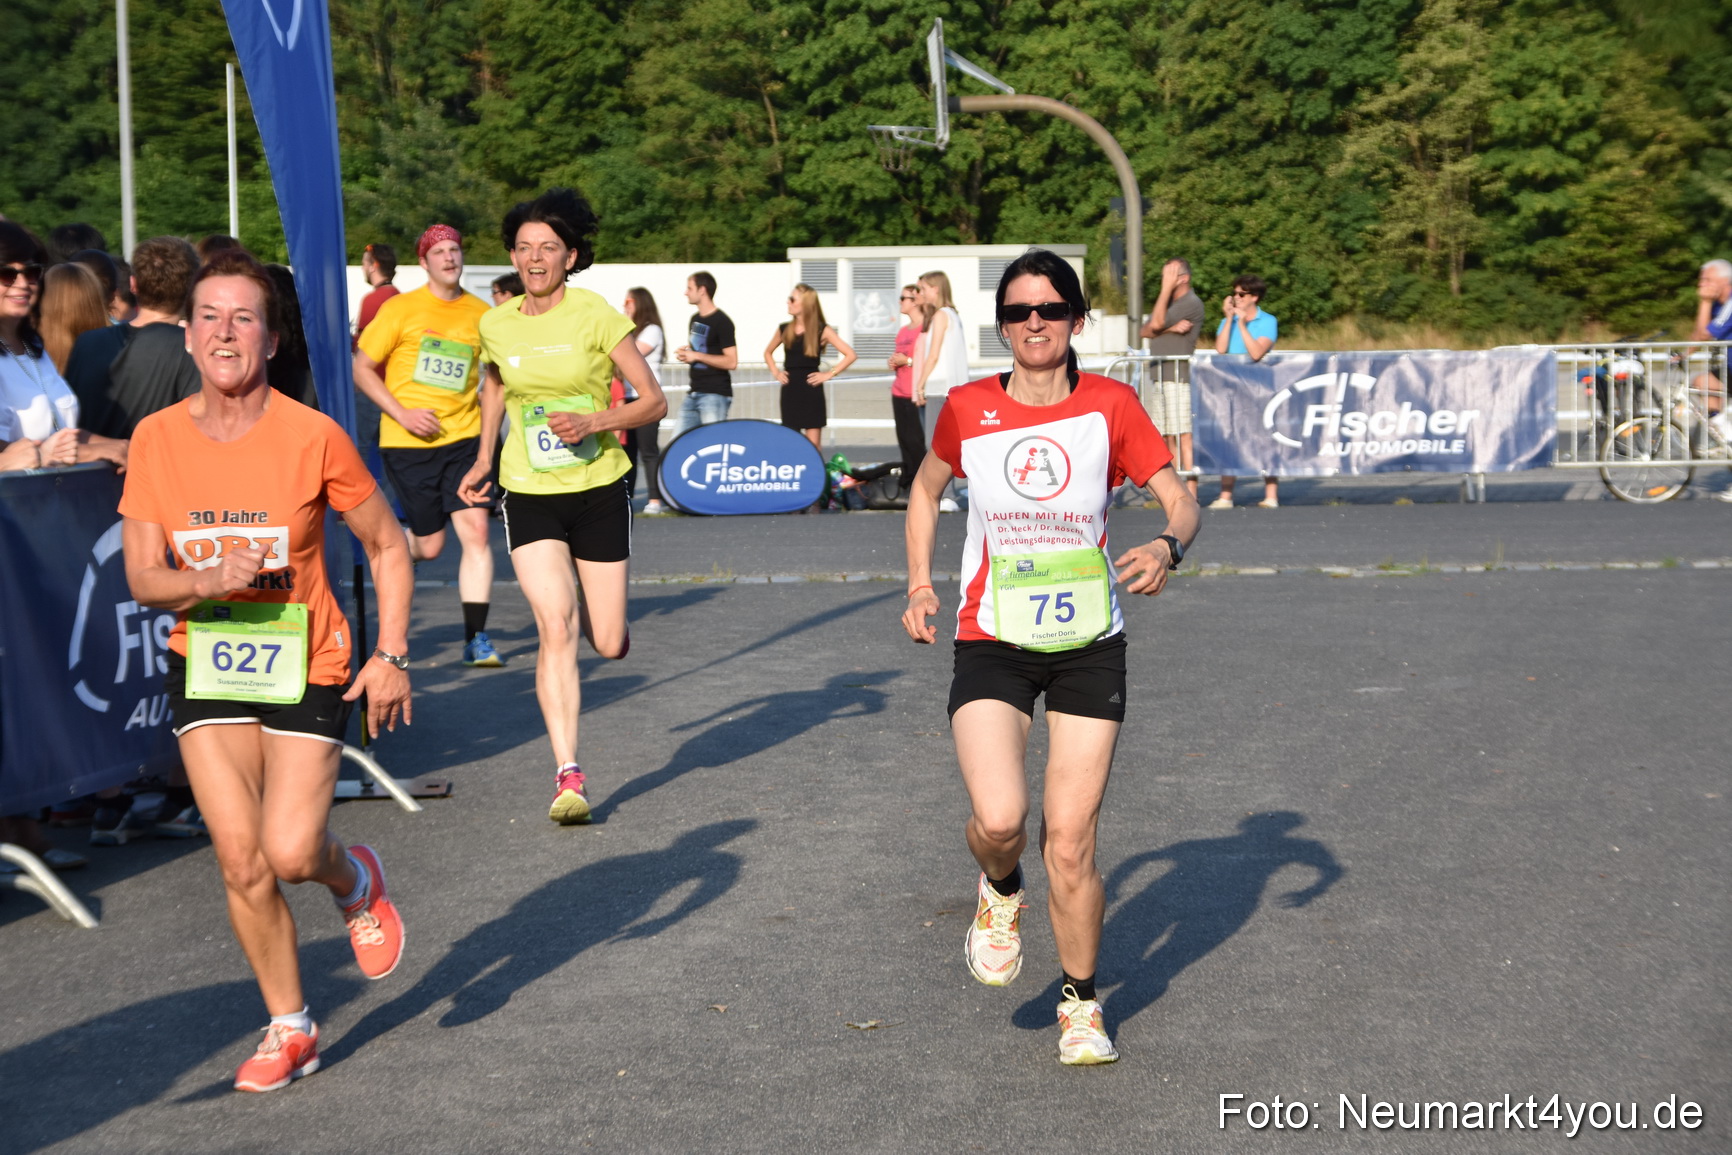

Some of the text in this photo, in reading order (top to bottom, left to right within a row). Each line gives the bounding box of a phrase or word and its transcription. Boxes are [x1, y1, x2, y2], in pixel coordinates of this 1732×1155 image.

[422, 357, 465, 378] 1335
[1302, 401, 1481, 438] Fischer
[537, 430, 584, 452] 62
[1318, 438, 1466, 456] AUTOMOBILE
[705, 460, 807, 484] Fischer
[716, 482, 801, 494] AUTOMOBILE
[188, 509, 268, 526] 30 Jahre
[985, 510, 1094, 524] LAUFEN MIT HERZ
[1011, 524, 1032, 532] Heck
[1054, 525, 1084, 535] Röschl
[1000, 535, 1083, 546] Leistungsdiagnostik
[1009, 568, 1050, 579] firmenlauf
[1029, 591, 1076, 625] 75
[1031, 629, 1077, 640] Fischer Doris
[212, 641, 282, 674] 627
[217, 678, 276, 688] Susanna Zrenner
